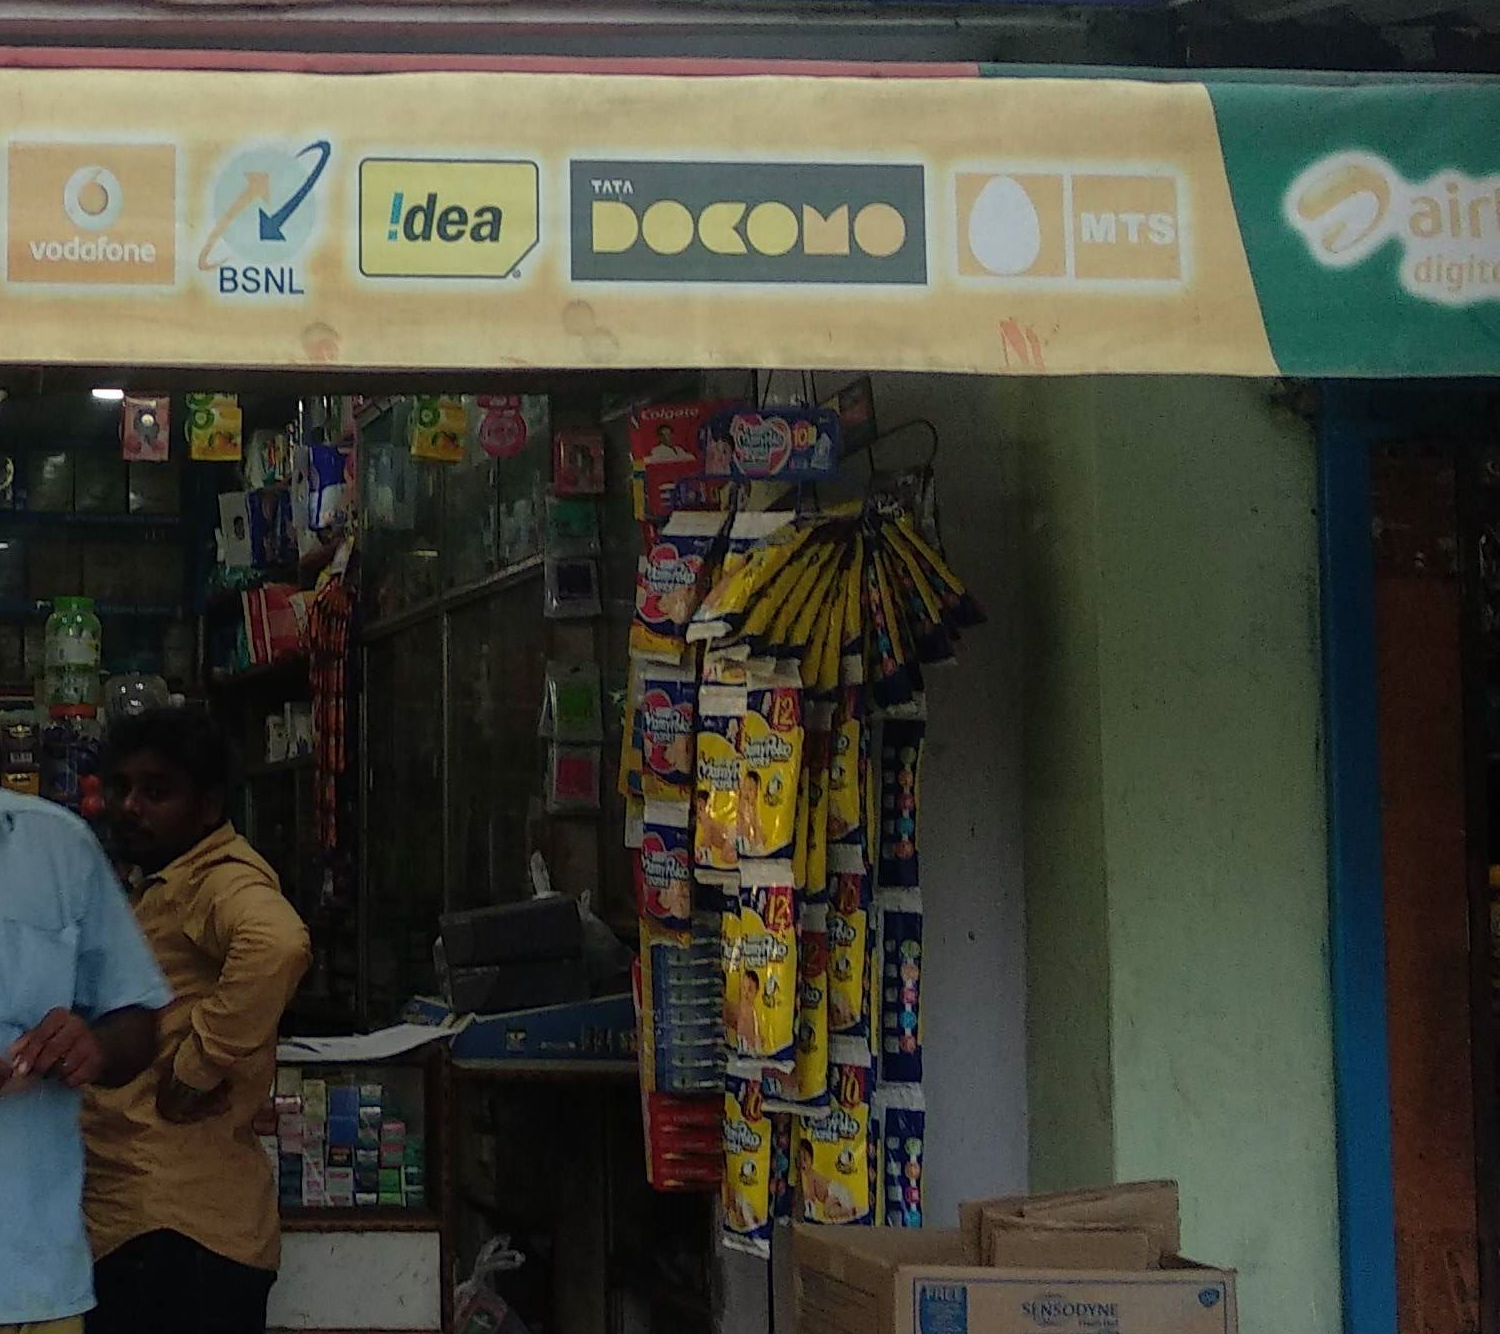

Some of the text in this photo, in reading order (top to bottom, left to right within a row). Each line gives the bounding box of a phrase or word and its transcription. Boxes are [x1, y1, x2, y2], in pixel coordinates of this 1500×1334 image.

[590, 178, 634, 194] TATA
[591, 199, 908, 259] DOCOMO
[1080, 211, 1176, 246] MTS
[29, 237, 156, 264] vodafone
[219, 266, 305, 294] BSNL
[640, 406, 700, 420] Colgate
[1021, 1301, 1119, 1319] SENSODYNE
